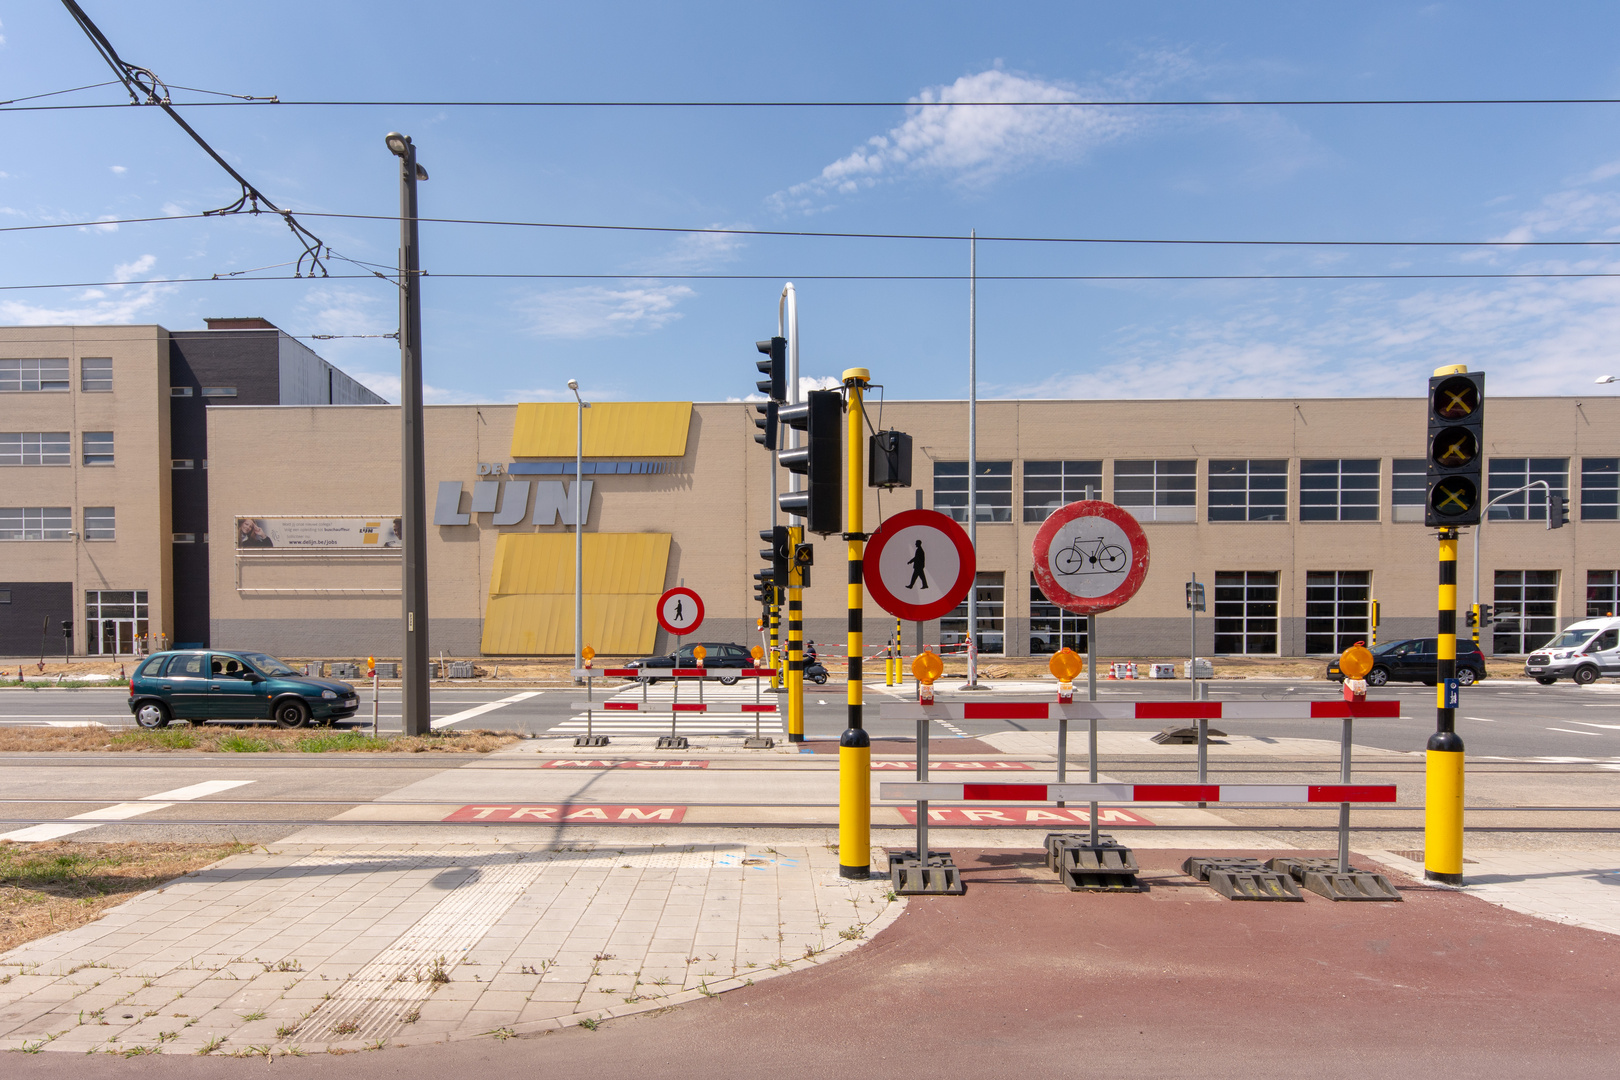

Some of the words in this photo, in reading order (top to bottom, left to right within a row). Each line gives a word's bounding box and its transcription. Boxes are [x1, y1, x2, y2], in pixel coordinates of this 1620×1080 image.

[476, 463, 502, 476] DE
[433, 481, 594, 525] LIJN
[471, 807, 675, 820] TRAM
[911, 809, 1138, 822] TRAM
